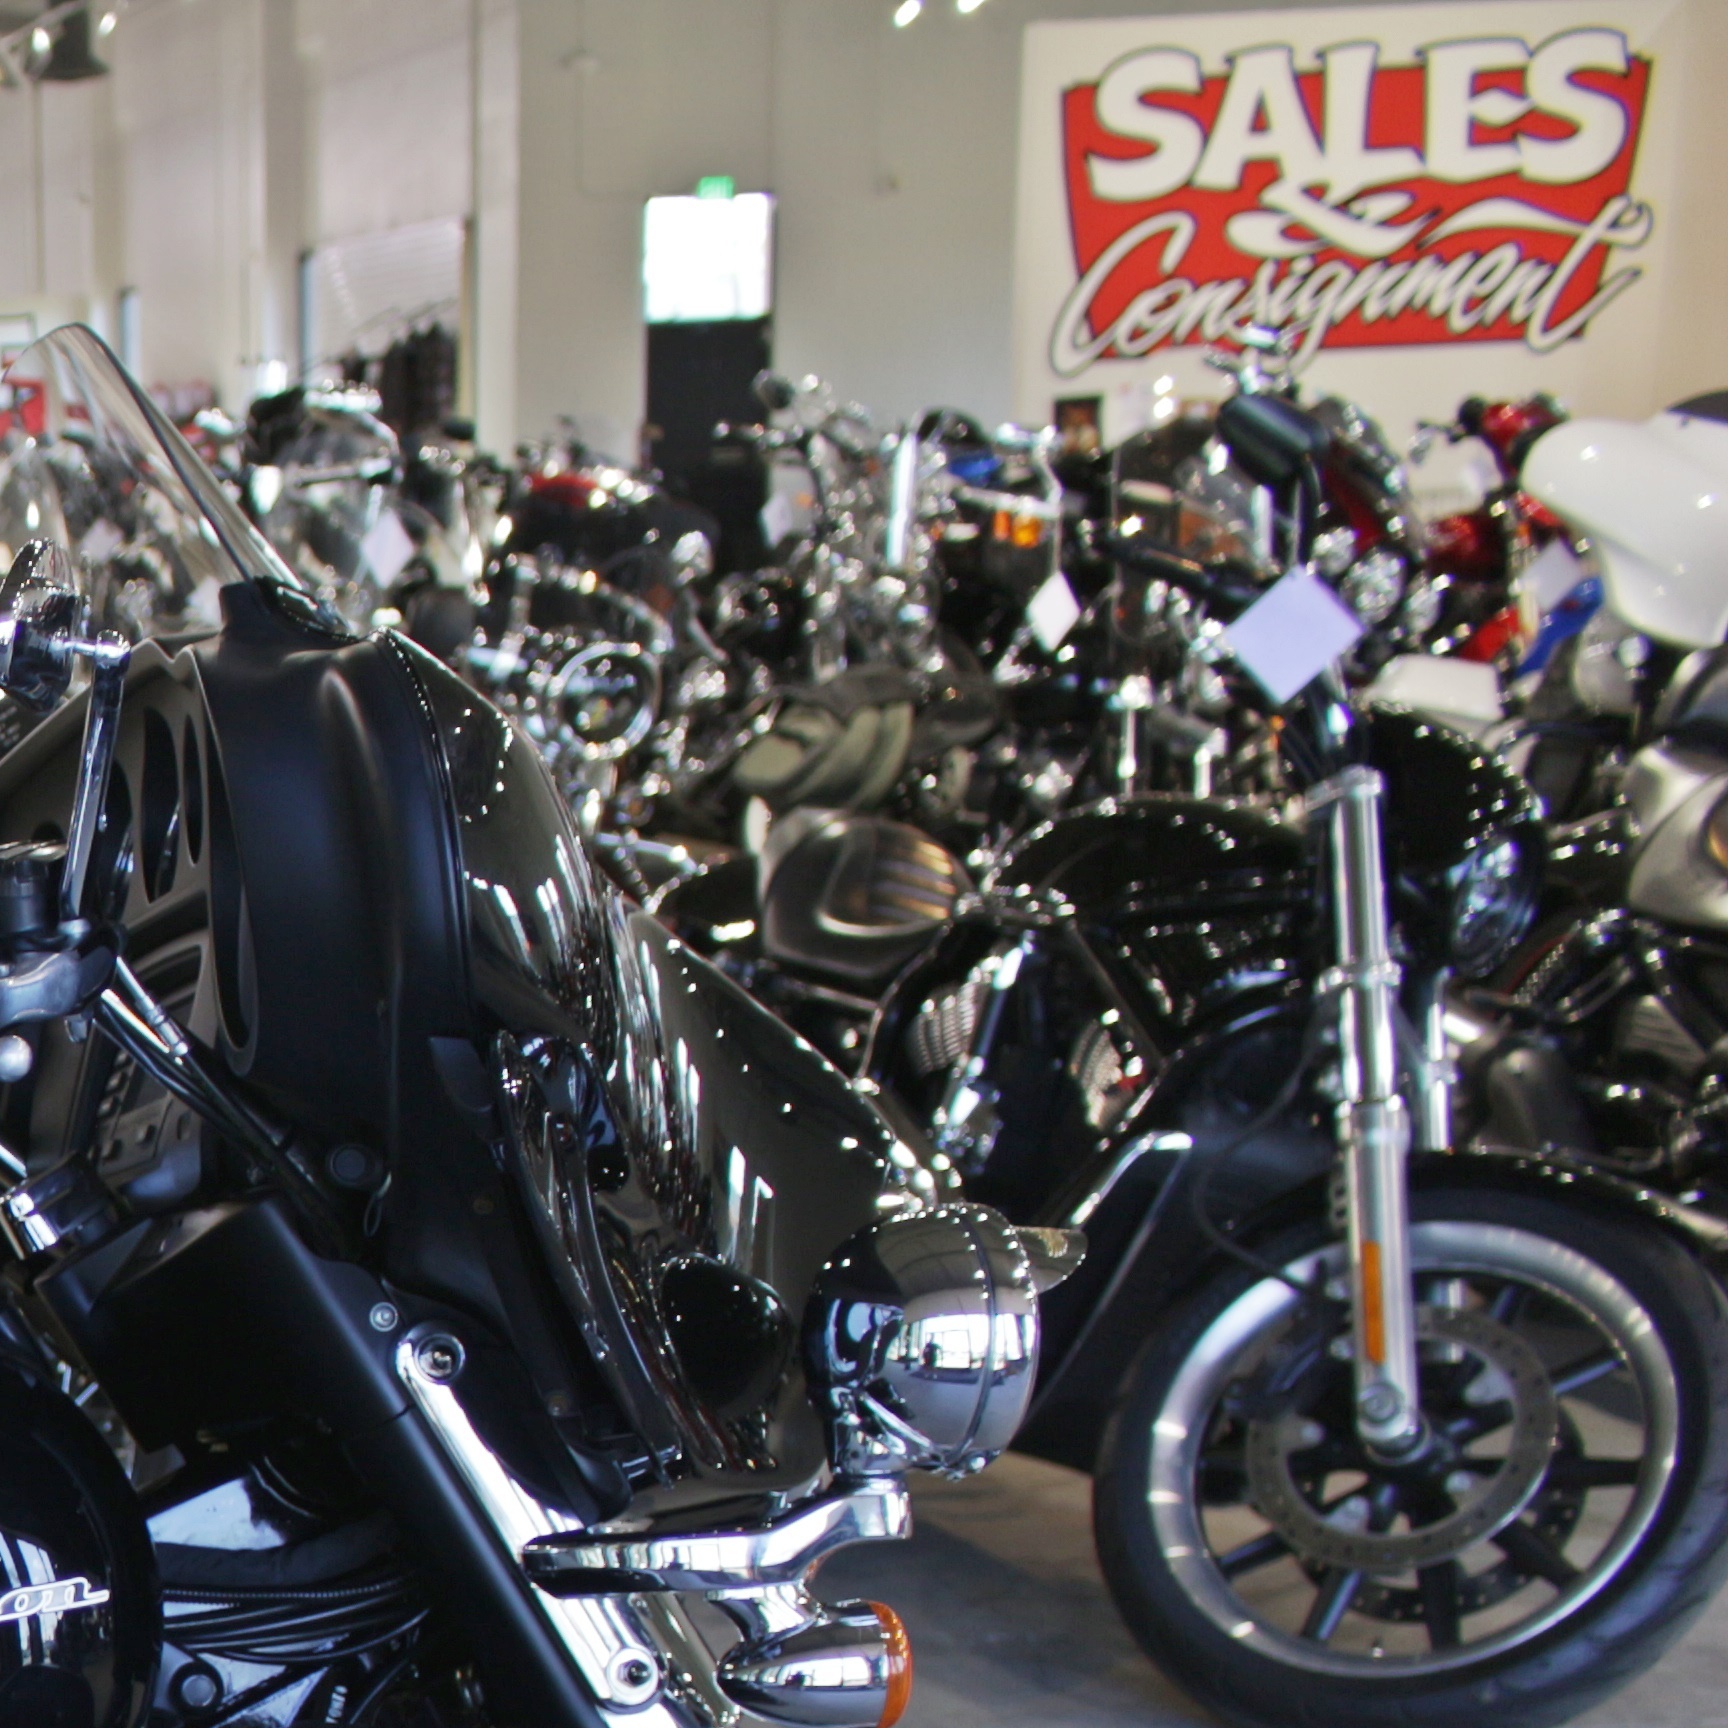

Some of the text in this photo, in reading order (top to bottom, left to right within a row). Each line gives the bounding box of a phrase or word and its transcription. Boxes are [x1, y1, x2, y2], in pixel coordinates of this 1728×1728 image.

[1085, 27, 1631, 201] SALES
[1050, 194, 1652, 377] Consignment
[1225, 178, 1441, 259] &
